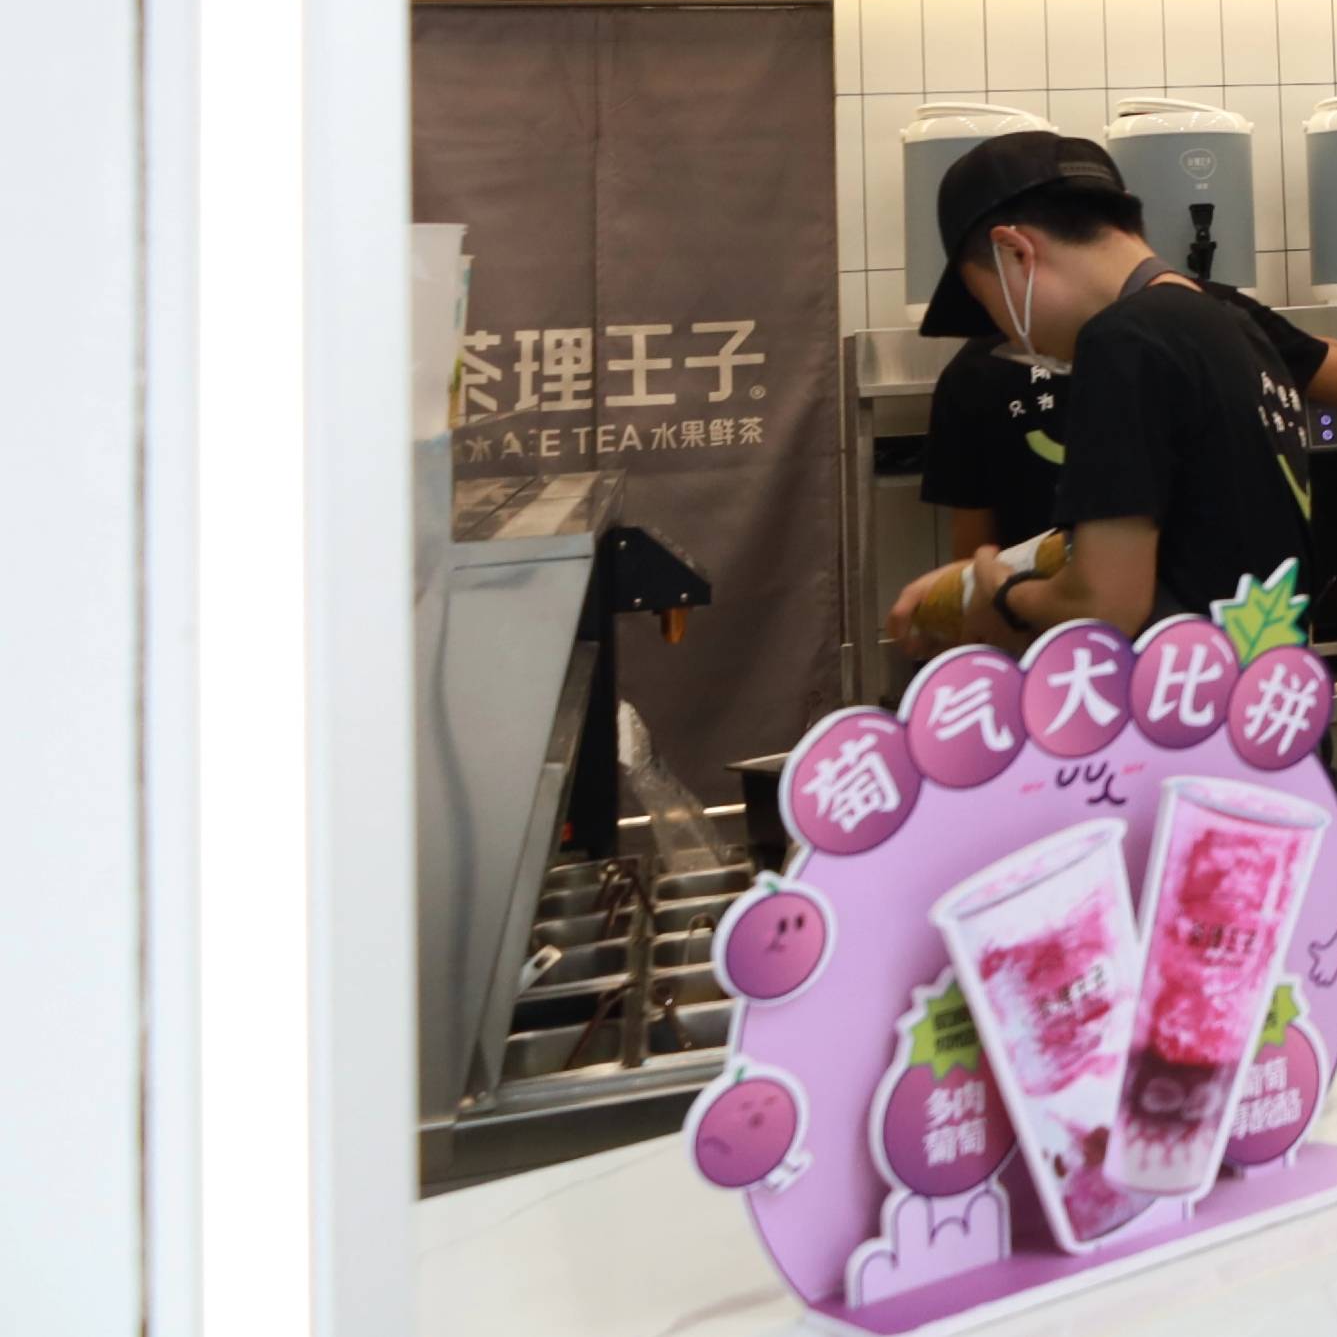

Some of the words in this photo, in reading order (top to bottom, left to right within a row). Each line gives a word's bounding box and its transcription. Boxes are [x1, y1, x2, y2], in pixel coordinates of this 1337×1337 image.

[573, 424, 642, 455] TEA
[651, 417, 764, 451] 水果鲜茶
[925, 1079, 986, 1125] 多肉
